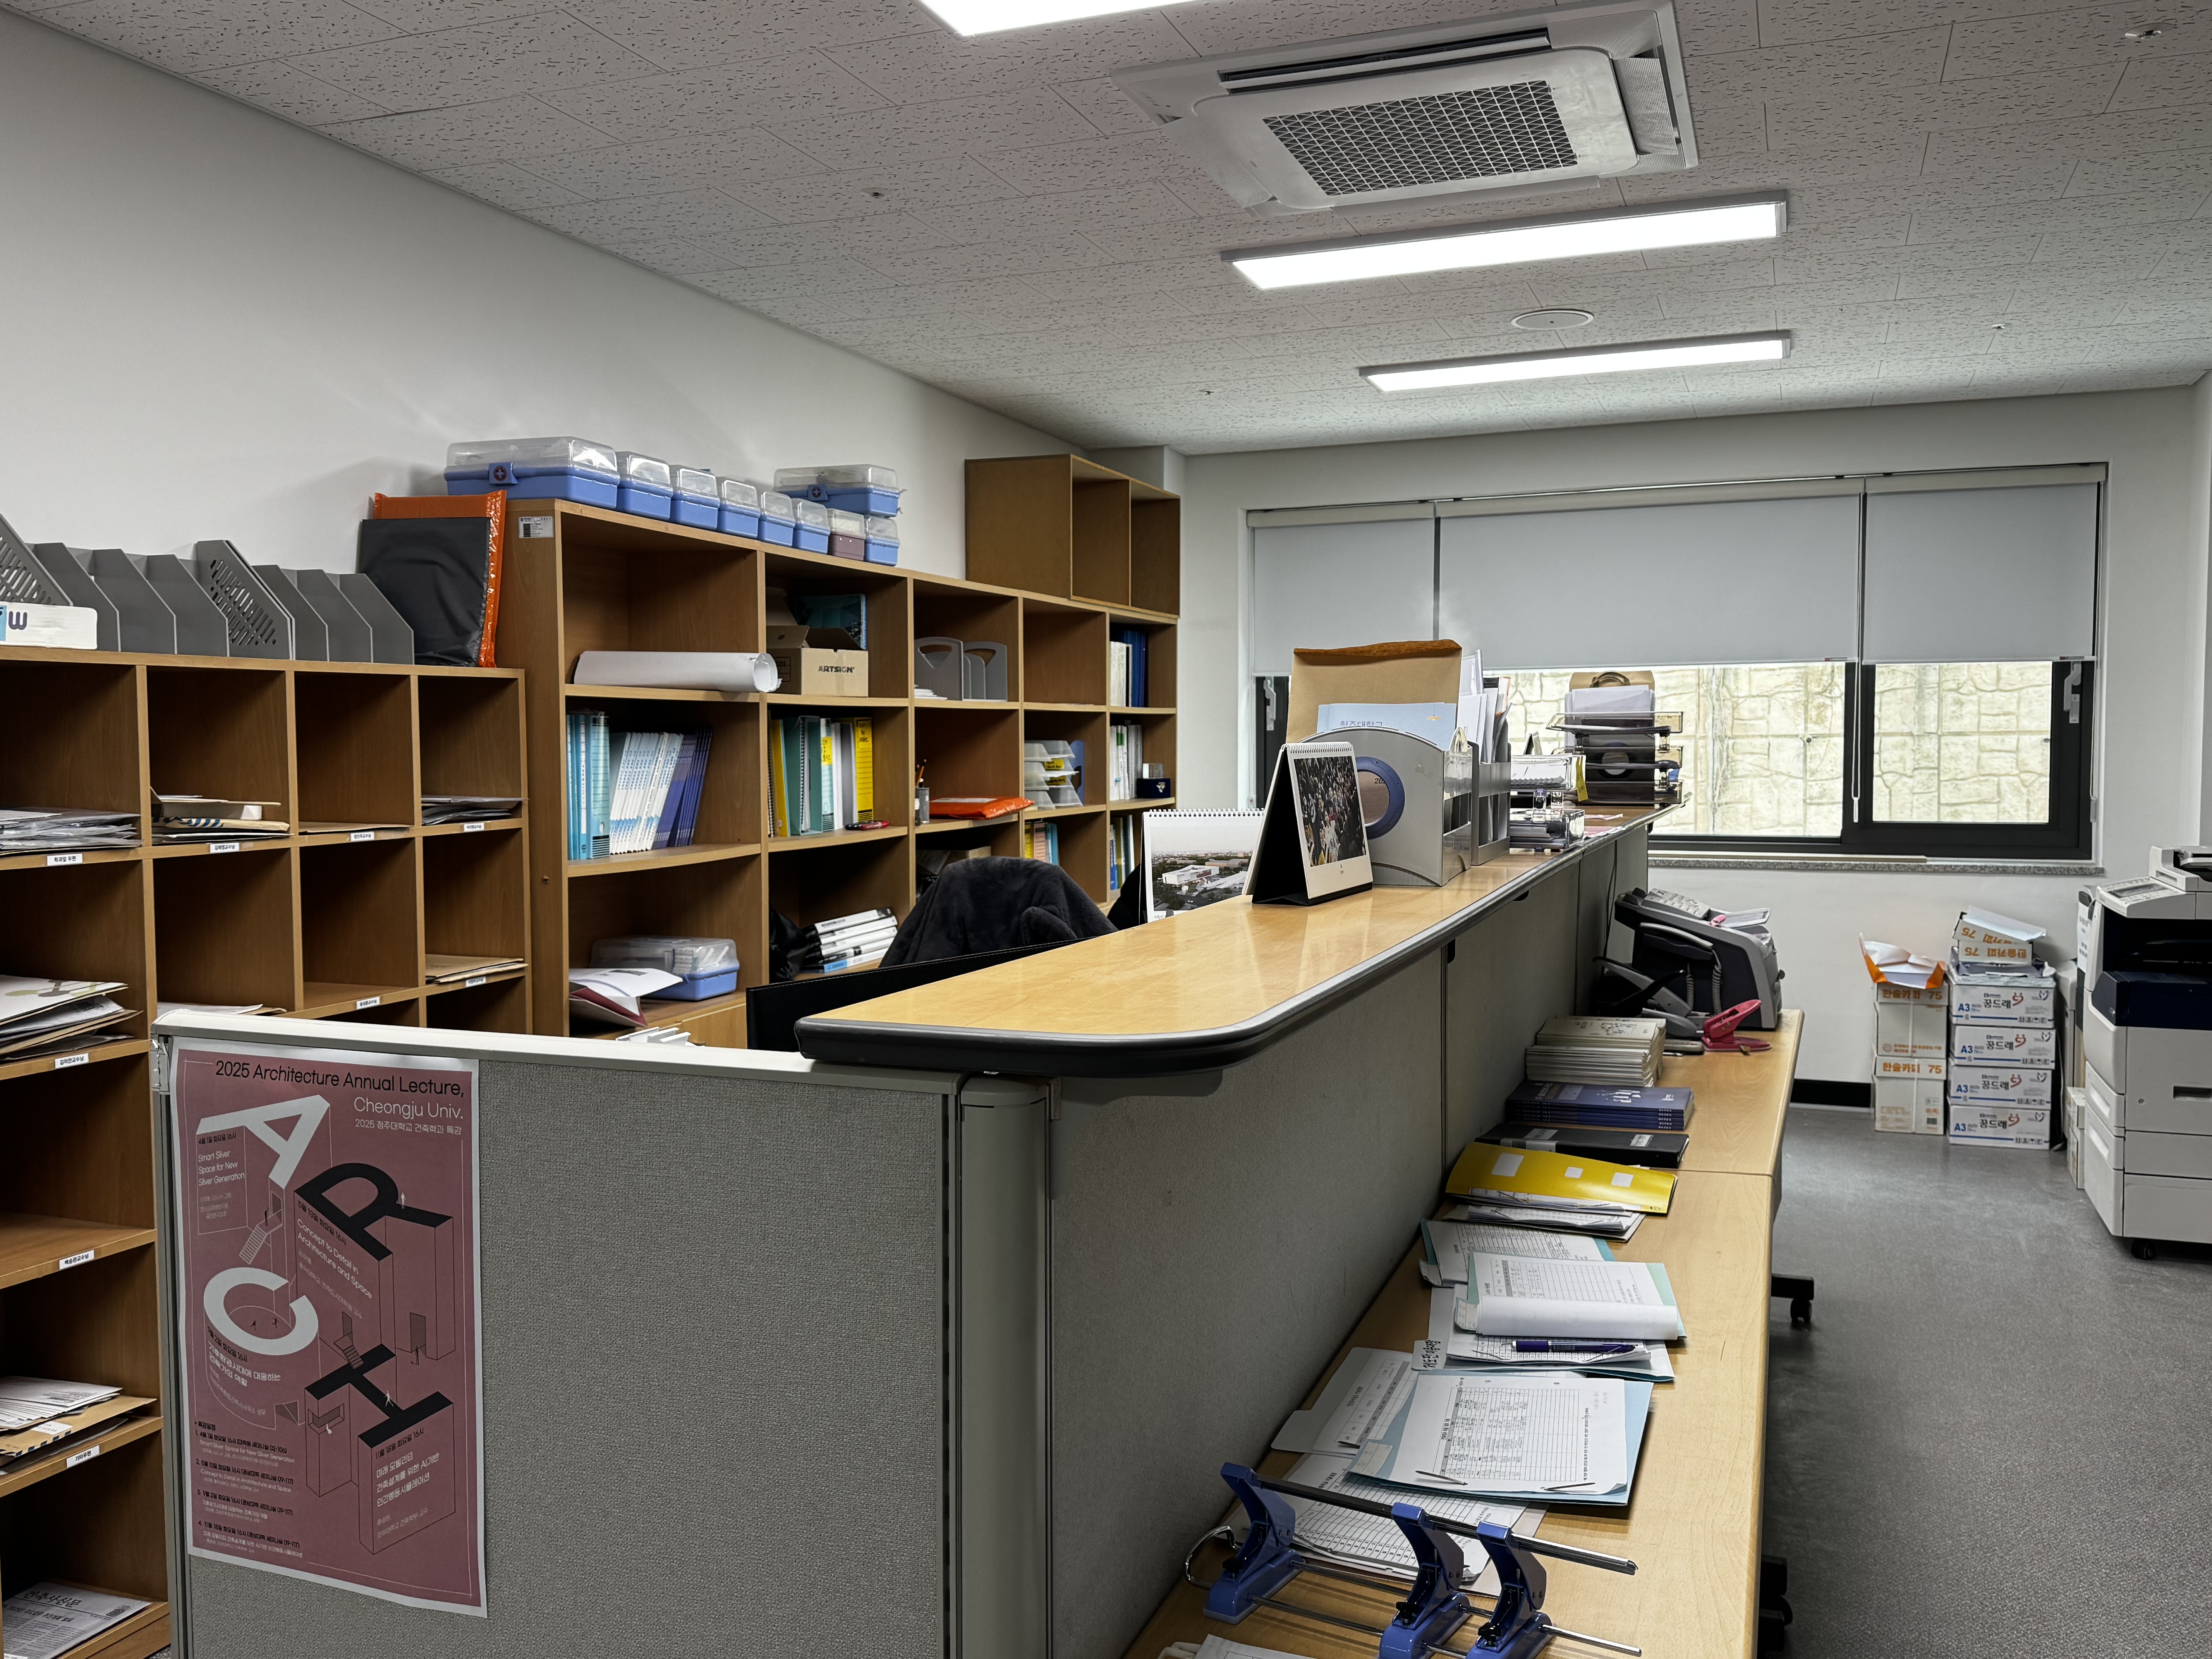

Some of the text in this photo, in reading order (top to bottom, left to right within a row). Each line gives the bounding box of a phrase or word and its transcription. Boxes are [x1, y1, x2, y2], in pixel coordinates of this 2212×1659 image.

[1961, 927, 1977, 939] 75
[1965, 947, 1980, 957] 75
[1882, 989, 1942, 1000] 한솔카피 75
[1958, 1003, 1970, 1012] A3
[1961, 1045, 1973, 1054] A3
[1882, 1062, 1942, 1074] 한솔카피 75
[216, 1060, 464, 1097] 2025 Architecture Annual Lecture,
[1956, 1084, 1968, 1093] A3
[354, 1097, 464, 1119] Cheongju Univ.
[355, 1119, 462, 1135] 2025 청주대학교 건축학과 특강
[1954, 1123, 1966, 1132] A3
[227, 1132, 236, 1140] 16시
[198, 1151, 230, 1162] Smart Silver
[198, 1166, 215, 1175] Space
[225, 1161, 238, 1170] New
[198, 1172, 245, 1186] Silver Generation
[298, 1201, 346, 1246] 5월 13일 화요일 16시
[297, 1219, 359, 1275] Concept to Detail in
[298, 1232, 372, 1298] Architecture and Space
[237, 1352, 247, 1363] 16시
[209, 1351, 233, 1379] 건축가의
[234, 1374, 247, 1387] 역할
[253, 1371, 281, 1381] 대응하는
[375, 1427, 424, 1459] 11월 18일 화요일 16시
[270, 1453, 294, 1464] Generation
[376, 1452, 413, 1479] 미래 모빌리티
[377, 1452, 440, 1493] 건축설계를 위한 AI기반
[201, 1469, 218, 1477] Concept
[241, 1477, 268, 1488] Architecture
[277, 1485, 291, 1493] Space
[377, 1472, 430, 1507] 인간행동시뮬레이션
